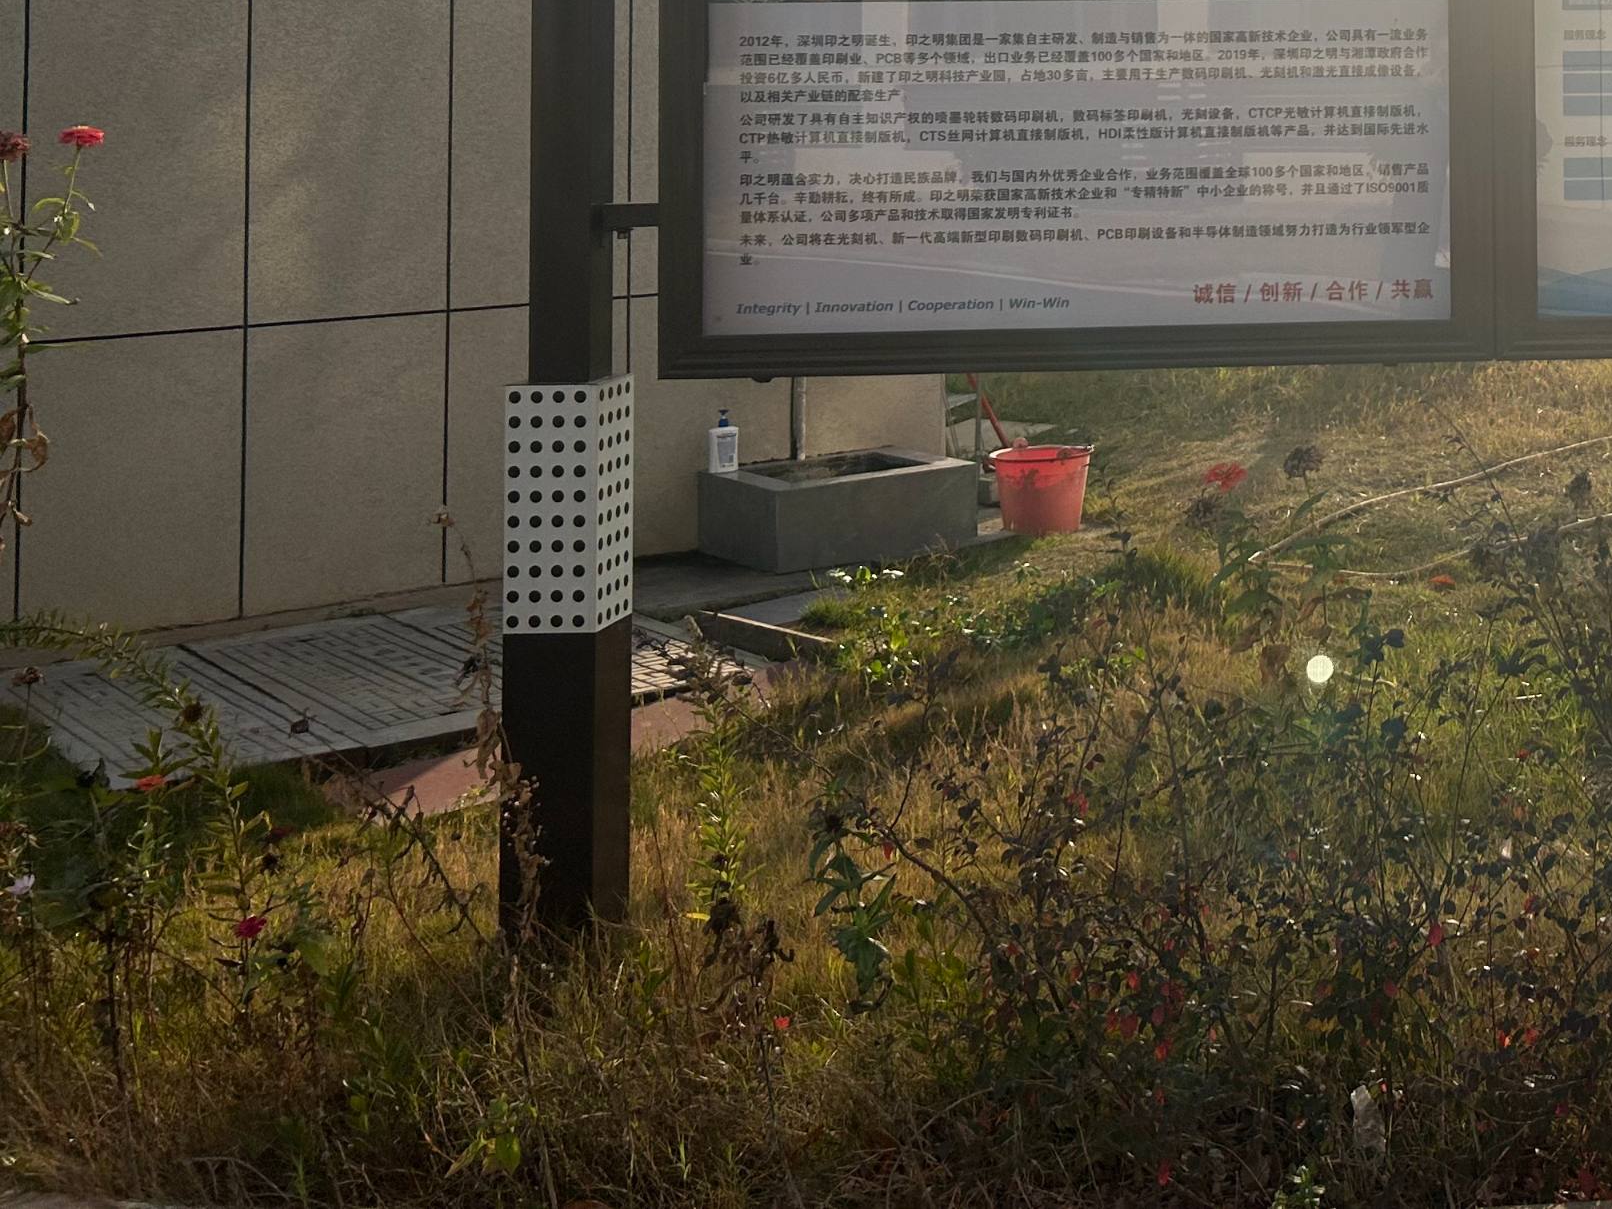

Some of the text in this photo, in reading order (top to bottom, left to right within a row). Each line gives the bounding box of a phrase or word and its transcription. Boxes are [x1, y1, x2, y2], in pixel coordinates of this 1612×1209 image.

[740, 150, 760, 164] 平。
[740, 253, 761, 267] 业。
[1193, 283, 1236, 305] 诚信
[1260, 281, 1304, 303] 创新
[1325, 279, 1369, 302] 合作
[1391, 278, 1434, 300] 共赢
[736, 301, 801, 317] Integrity
[815, 299, 894, 314] Innovation
[908, 297, 994, 314] Cooperation
[1009, 296, 1070, 310] Win-Win
